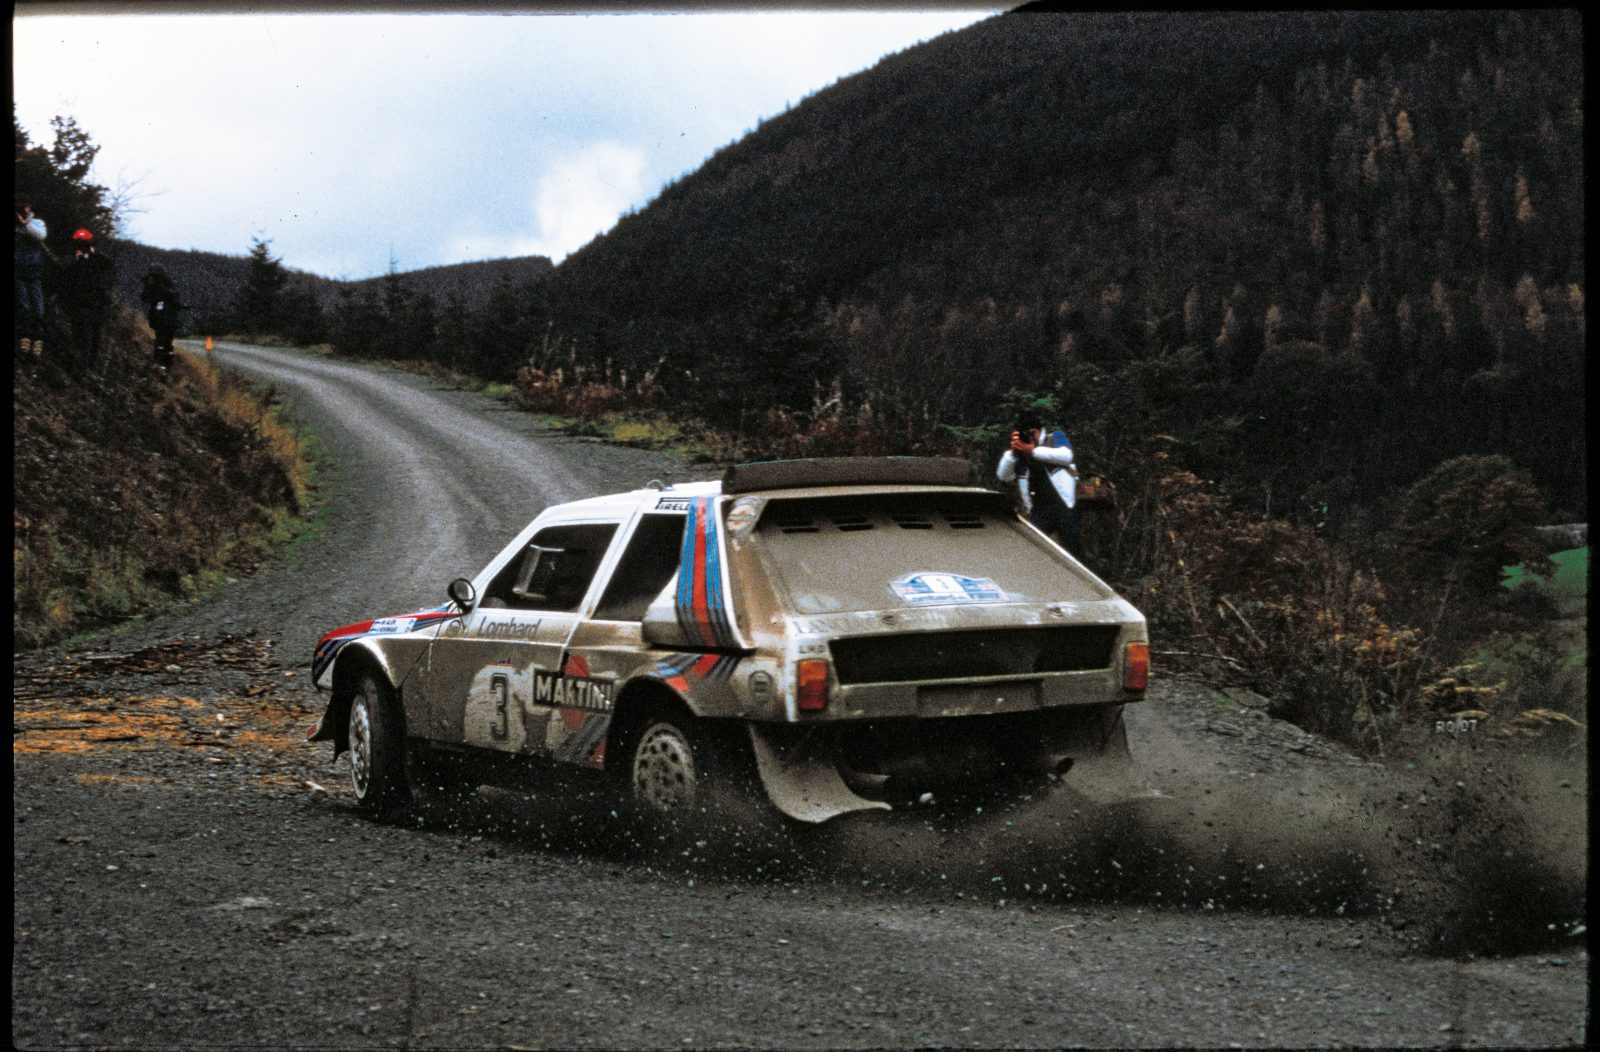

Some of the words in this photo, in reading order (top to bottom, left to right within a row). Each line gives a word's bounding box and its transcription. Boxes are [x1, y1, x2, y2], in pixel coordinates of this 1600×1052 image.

[655, 497, 689, 510] PIRELL
[479, 616, 543, 638] Lombard
[536, 675, 612, 709] MARTINI
[489, 672, 508, 741] 3
